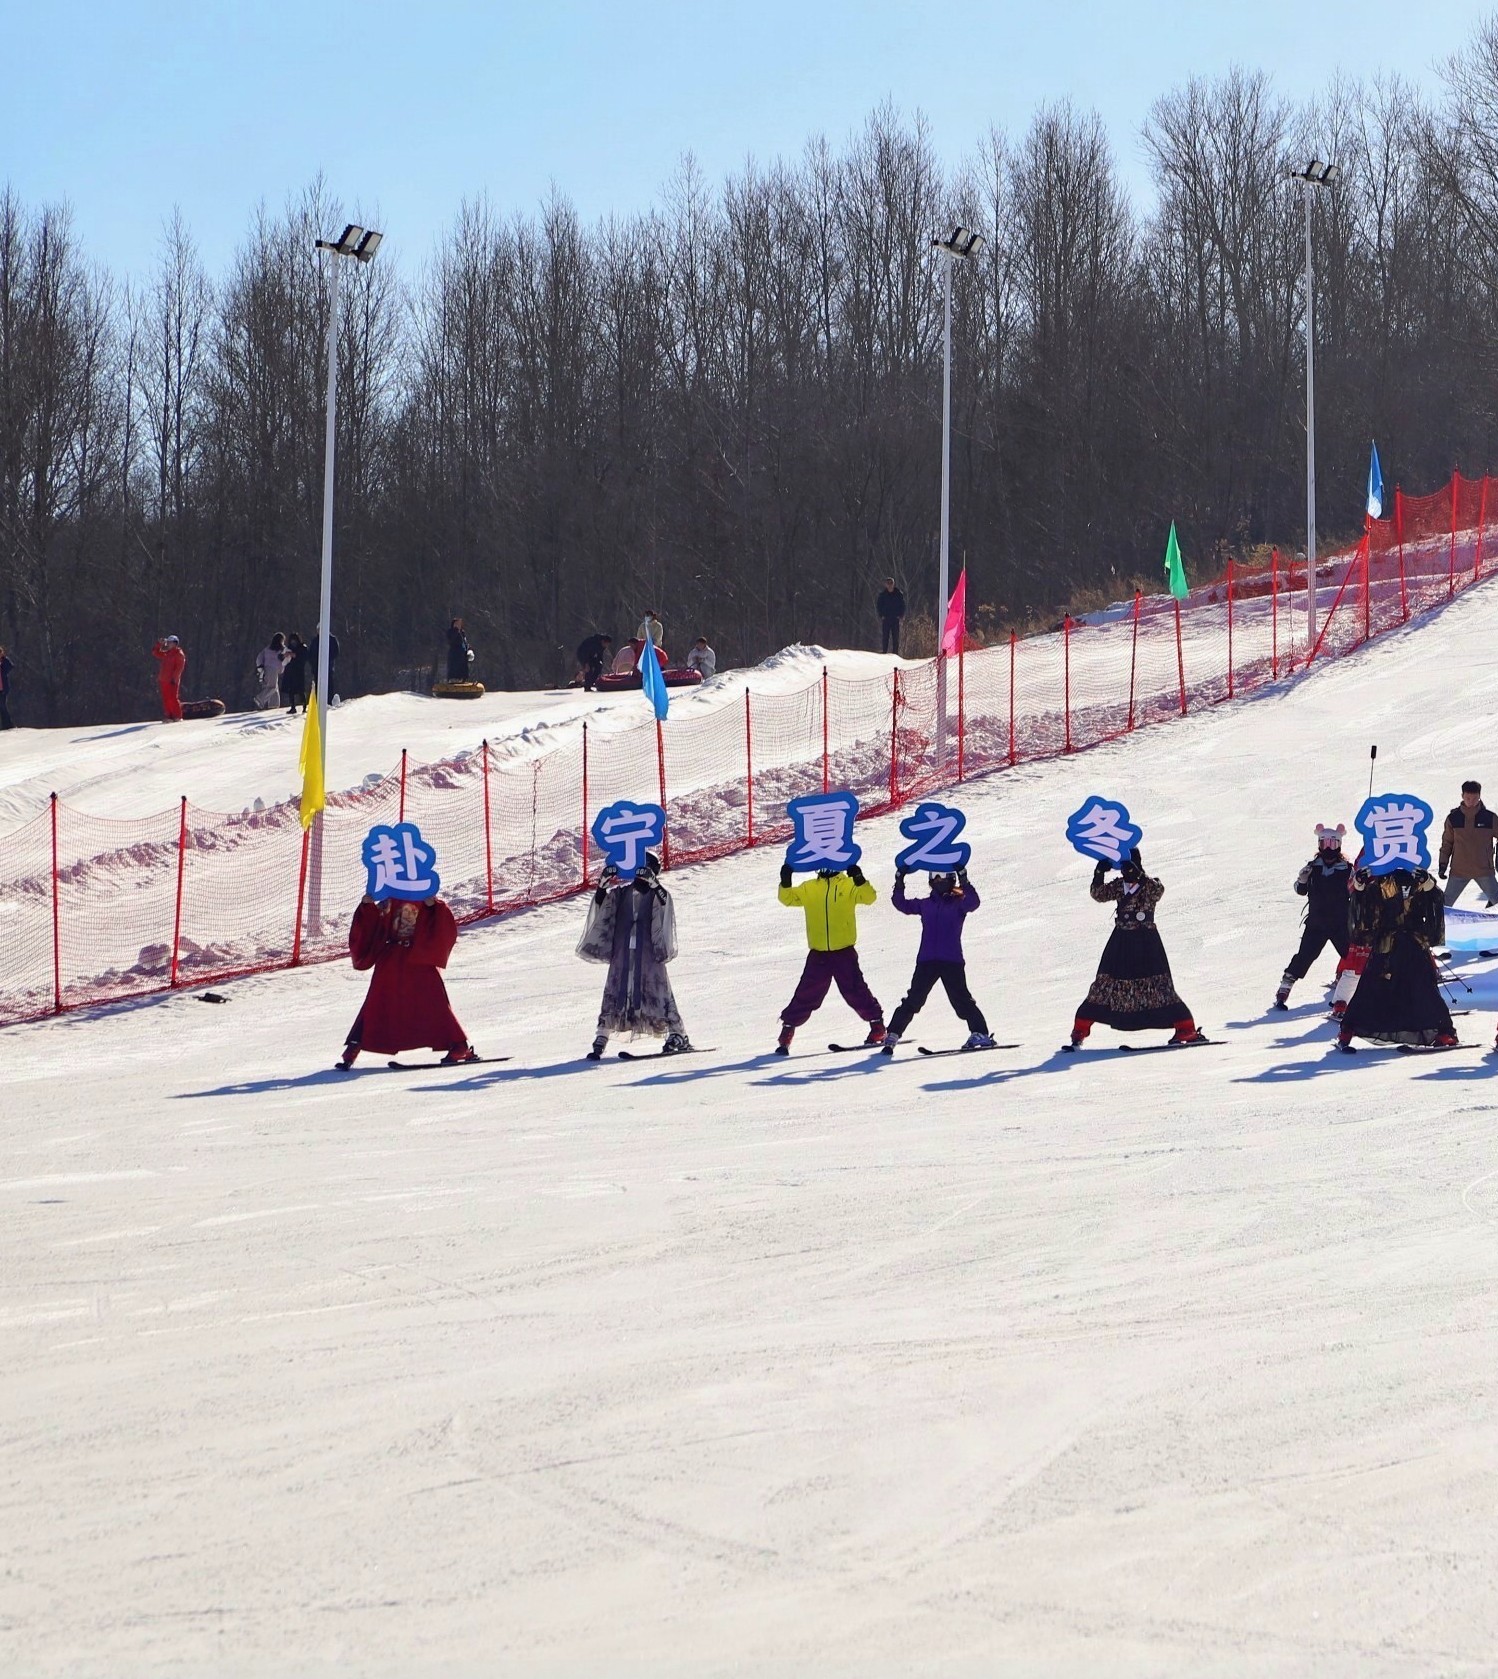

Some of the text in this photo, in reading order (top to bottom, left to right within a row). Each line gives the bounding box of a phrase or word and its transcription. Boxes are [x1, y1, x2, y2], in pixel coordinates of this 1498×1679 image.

[371, 832, 431, 891] 赴
[600, 810, 657, 870] 宁
[794, 801, 852, 863] 夏
[904, 811, 962, 866] 之
[1078, 804, 1132, 862] 冬
[1363, 801, 1425, 866] 赏
